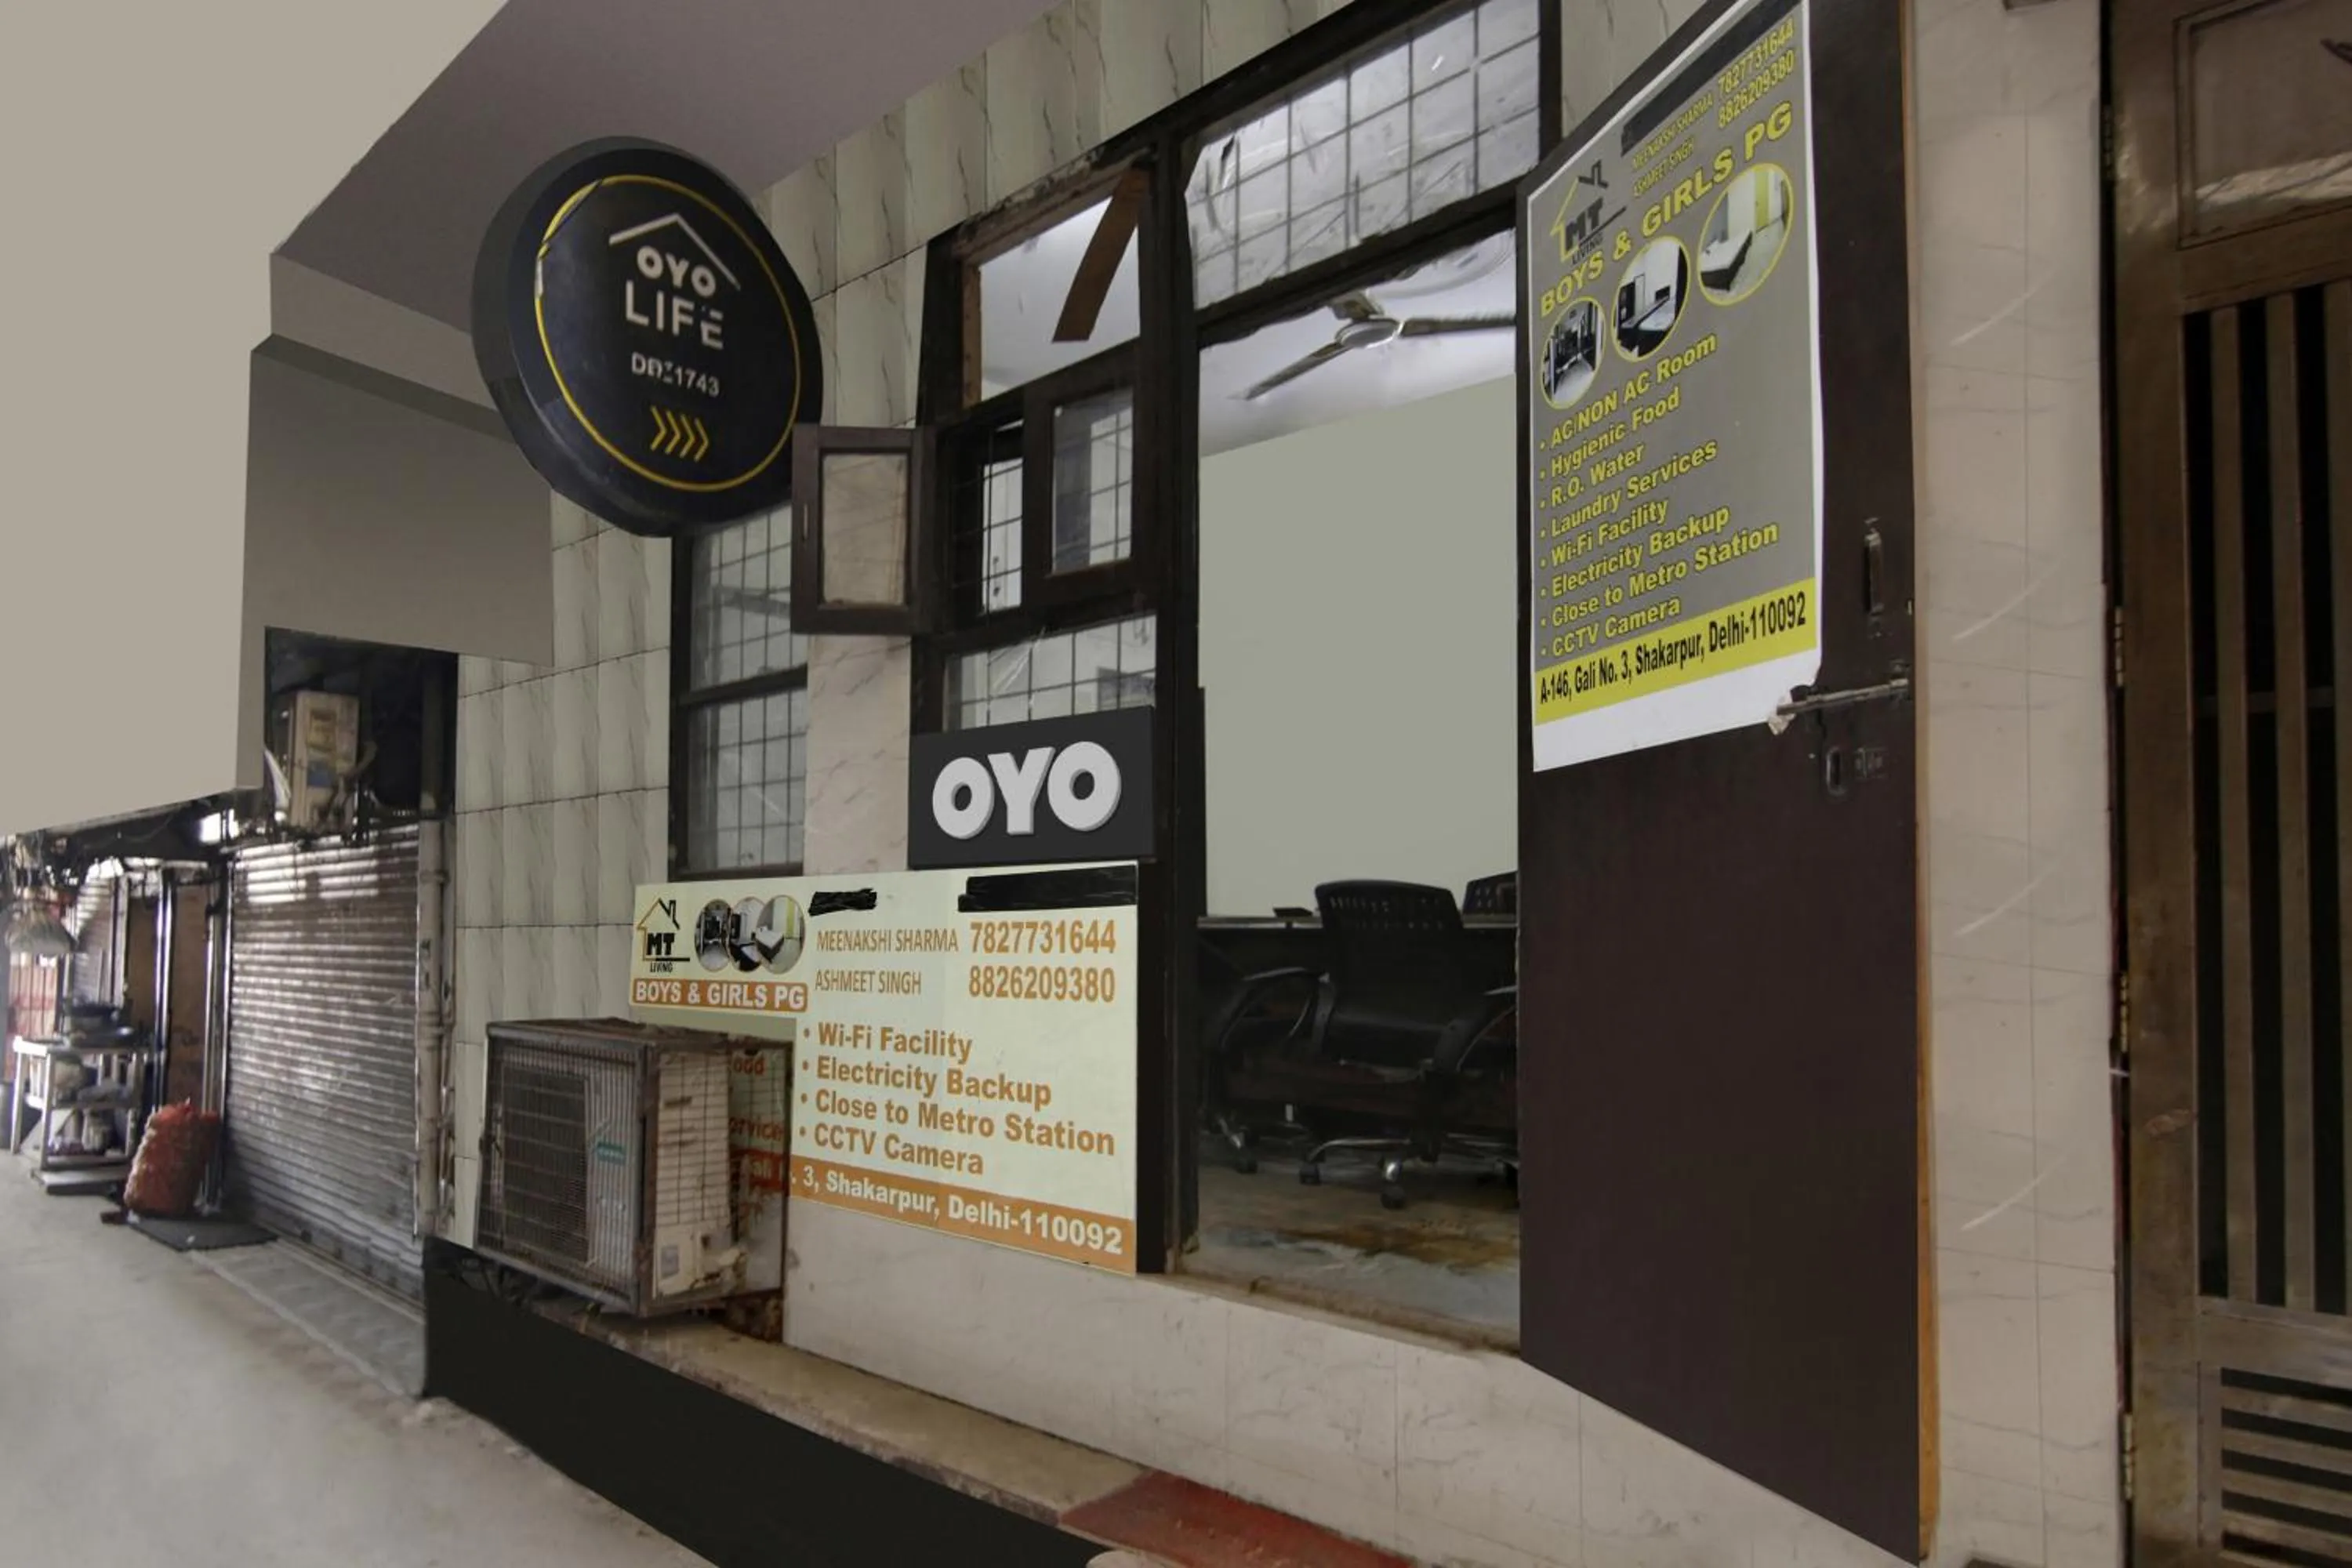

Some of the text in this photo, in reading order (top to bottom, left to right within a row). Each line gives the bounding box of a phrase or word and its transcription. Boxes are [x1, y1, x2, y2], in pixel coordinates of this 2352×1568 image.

[1718, 17, 1795, 97] 7827731644
[1718, 49, 1795, 128] 8826209380
[1541, 100, 1792, 318] BOYS & GIRLS PG
[1565, 198, 1603, 251] MT
[637, 245, 717, 299] OYO
[626, 280, 724, 350] LIFE
[1623, 371, 1650, 404] AC
[1657, 332, 1718, 383] Room
[1552, 386, 1680, 477] Hygienic Food
[1551, 440, 1718, 538] Laundry Services
[1552, 444, 1645, 506] R.O. Water
[1552, 500, 1668, 567] Wi-Fi Facility
[1552, 505, 1730, 597] Electricity Backup
[1552, 523, 1779, 627] Close to Metro Station
[1541, 590, 1806, 704] A-146, Gali No. 3, Shakarpur, Delhi-110092
[1552, 597, 1681, 657] CCTV Camera
[932, 741, 1122, 840] OYO
[647, 932, 675, 956] MT
[650, 962, 673, 973] LIVING
[816, 928, 960, 953] MEENAKSHI SHARMA
[970, 920, 1116, 955] 7827731644
[636, 981, 805, 1011] BOYS & GIRLS PG
[815, 968, 922, 995] ASHMEET SINGH
[969, 965, 1115, 1003] 8826209380
[818, 1022, 973, 1065] Wi-Fi Facility
[816, 1055, 1052, 1111] Electricity Backup
[814, 1123, 984, 1175] CCTV Camera
[815, 1089, 1115, 1156] Close to Metro Station
[803, 1166, 1123, 1254] 3, Shakarpur, Delhi-110092
